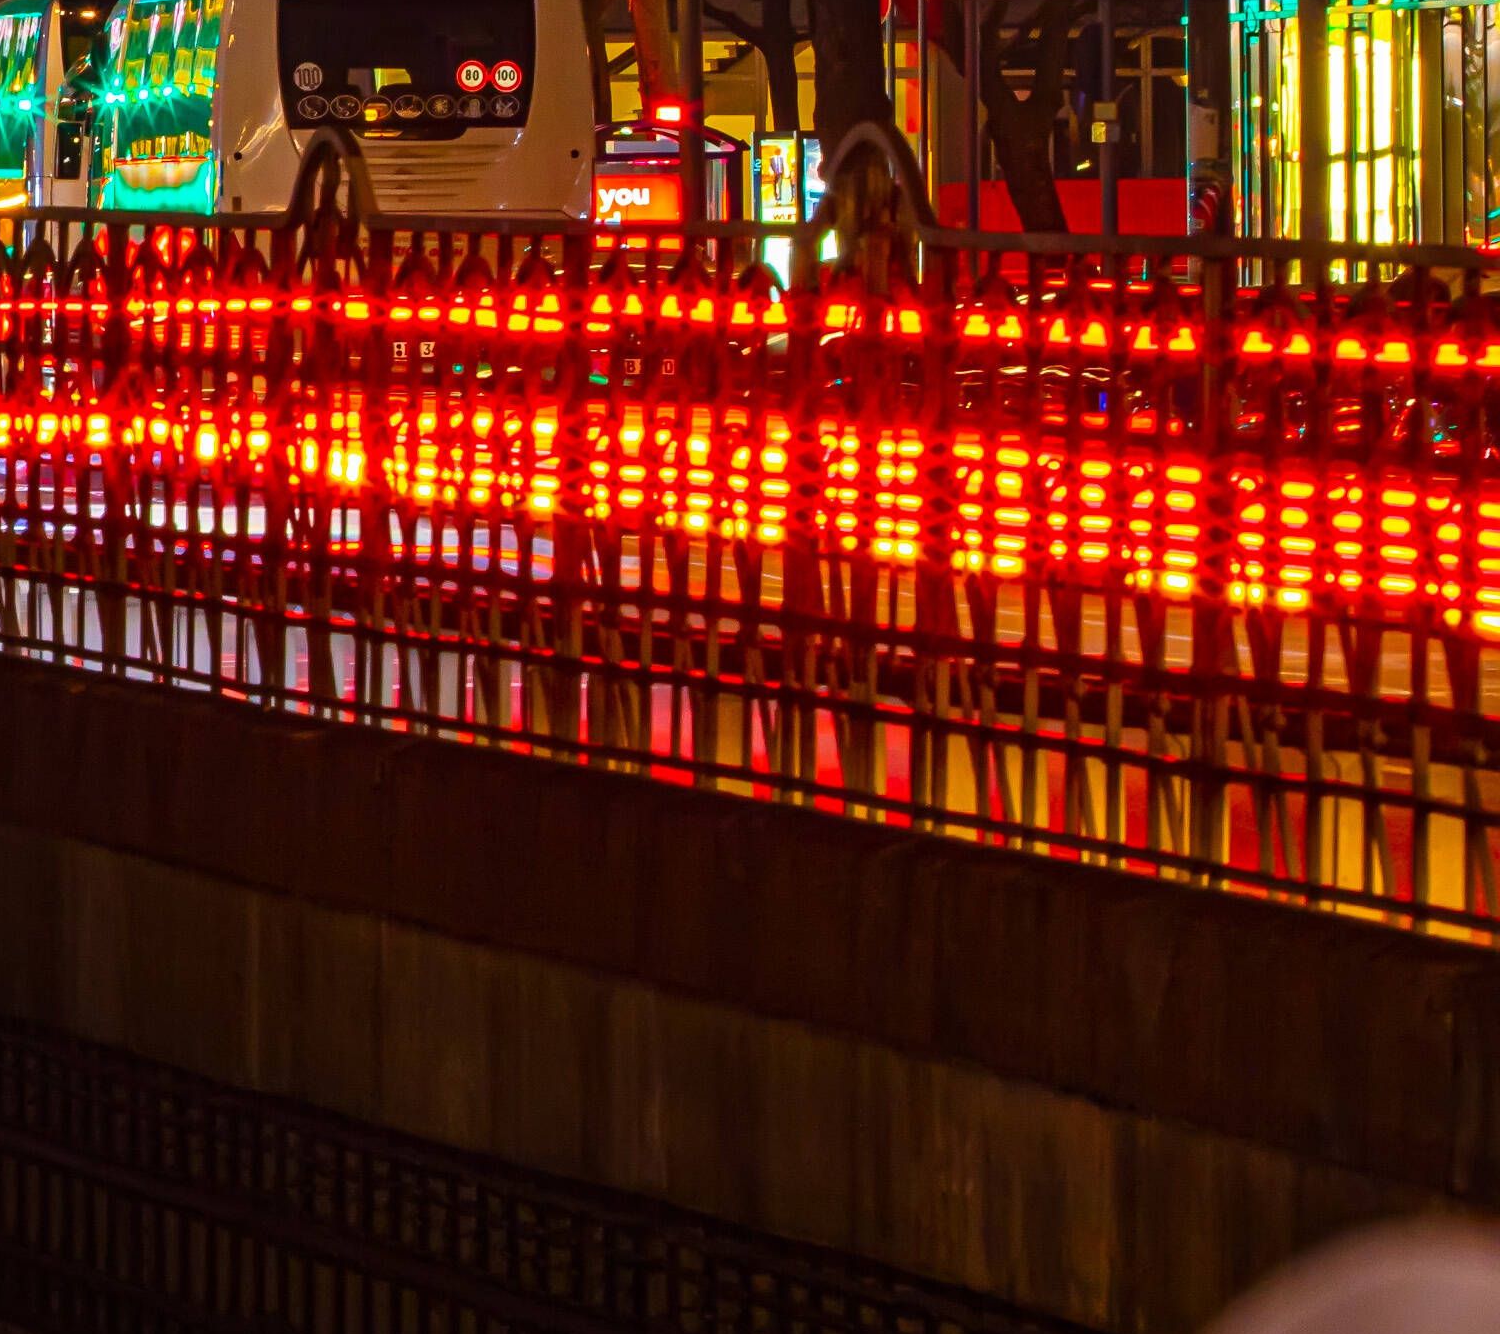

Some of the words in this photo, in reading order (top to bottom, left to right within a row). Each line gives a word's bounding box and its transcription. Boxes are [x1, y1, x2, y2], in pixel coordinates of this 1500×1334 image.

[464, 69, 480, 81] 80
[497, 69, 516, 81] 100
[597, 187, 650, 214] you
